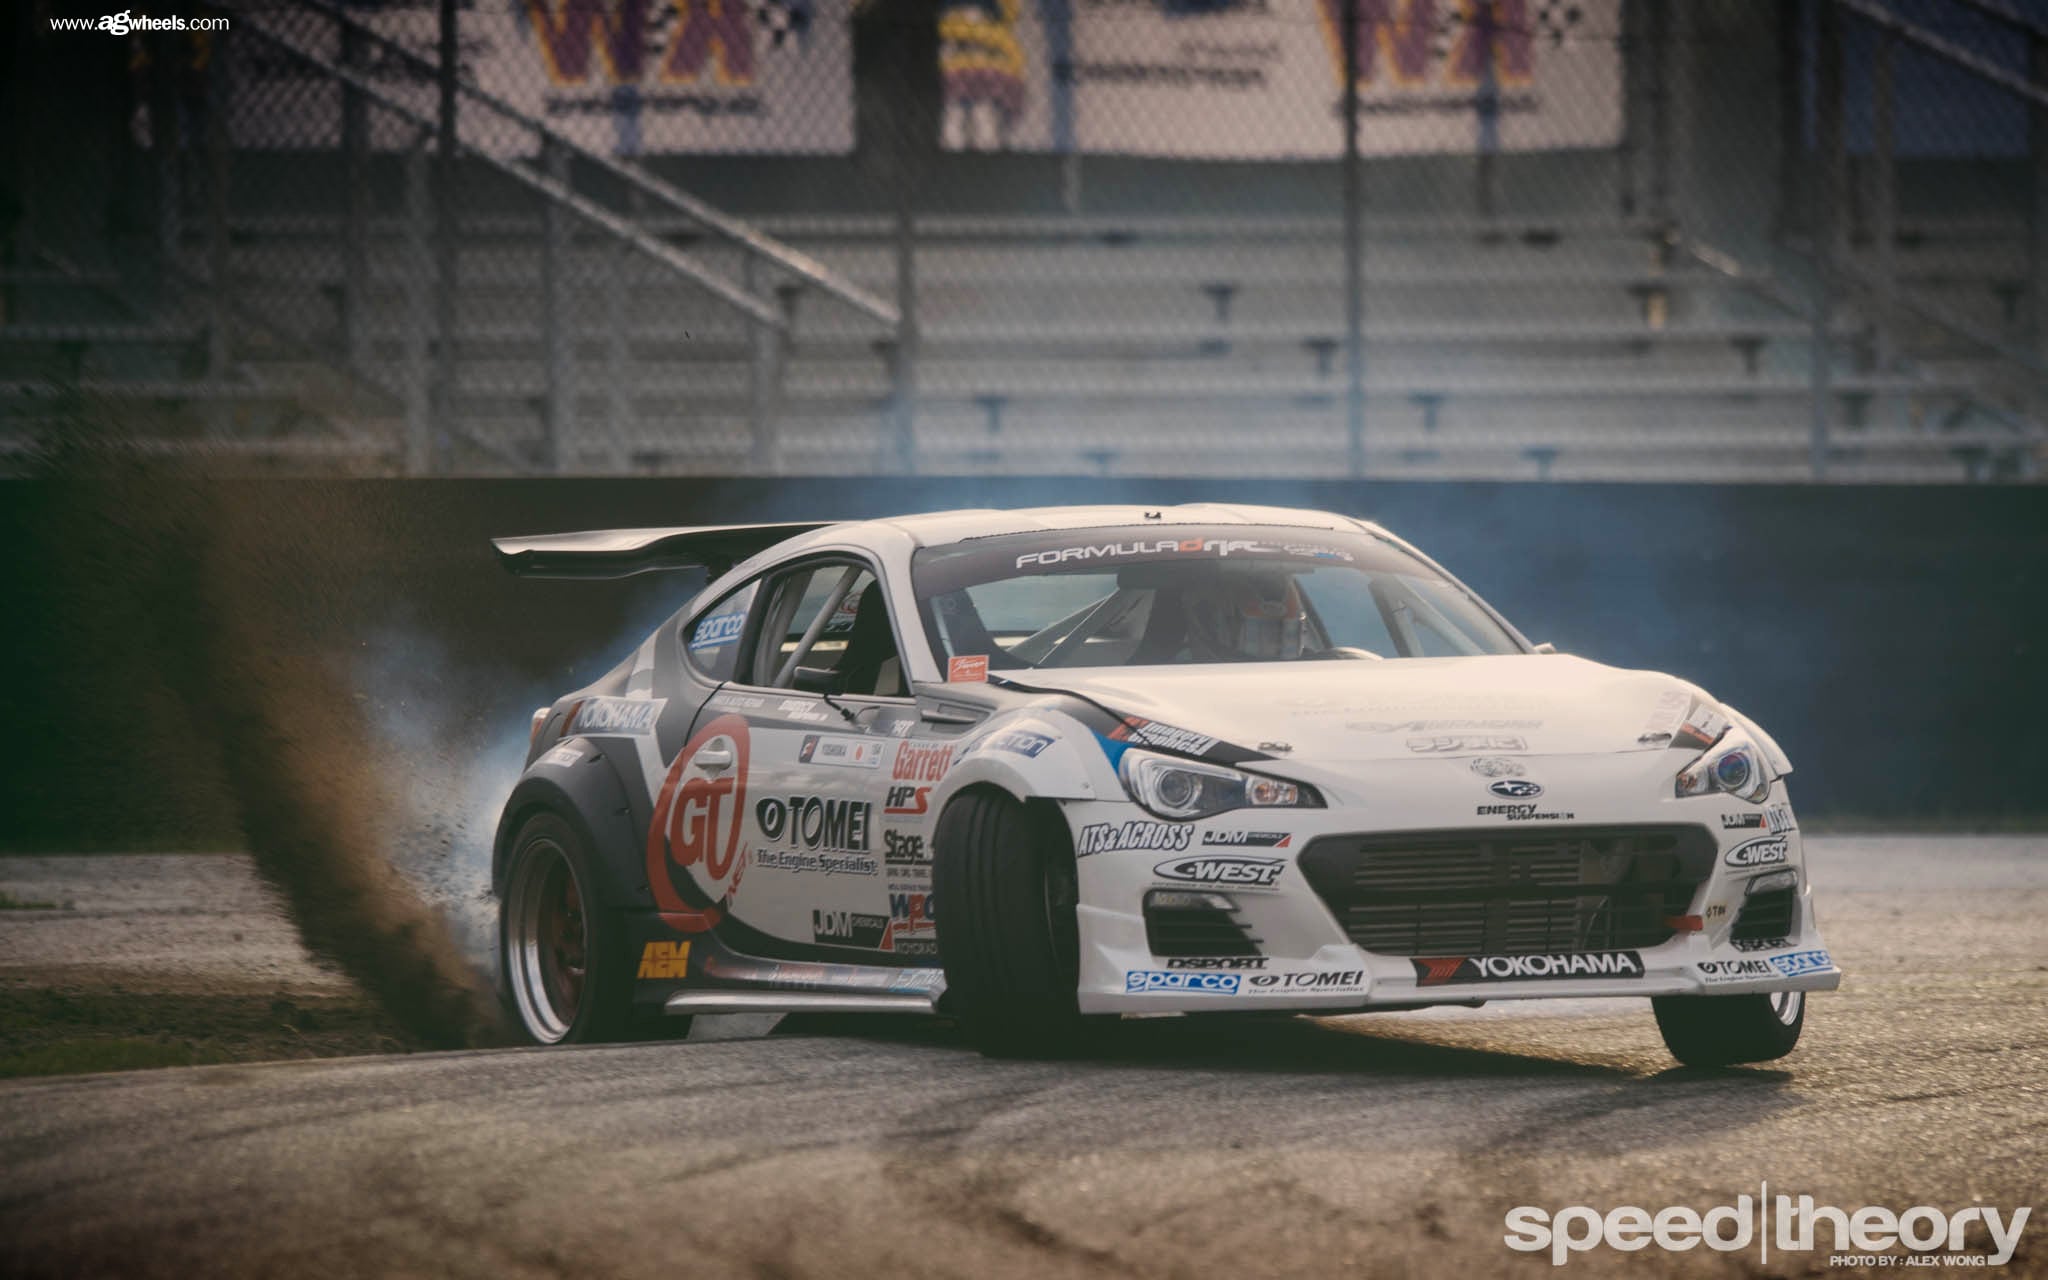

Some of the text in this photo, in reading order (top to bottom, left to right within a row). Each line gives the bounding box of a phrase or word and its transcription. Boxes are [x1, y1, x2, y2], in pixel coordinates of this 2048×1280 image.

[695, 612, 747, 642] sparco
[892, 738, 955, 782] Garrett
[883, 786, 933, 815] HPS
[1477, 803, 1537, 815] ENERGY
[787, 796, 872, 852] TOMEI
[1203, 831, 1248, 844] JDM
[884, 829, 924, 865] Stage
[1078, 820, 1195, 858] ATS&ACROSS
[757, 848, 778, 867] The
[779, 851, 817, 873] Engine
[819, 854, 878, 876] Specialist
[813, 909, 853, 938] JDM
[1167, 957, 1269, 970] DSPORT
[1469, 953, 1639, 977] YOKOHAMA
[1715, 959, 1773, 976] TOMEI
[1127, 971, 1239, 994] sparco
[1284, 970, 1364, 986] TOMEI
